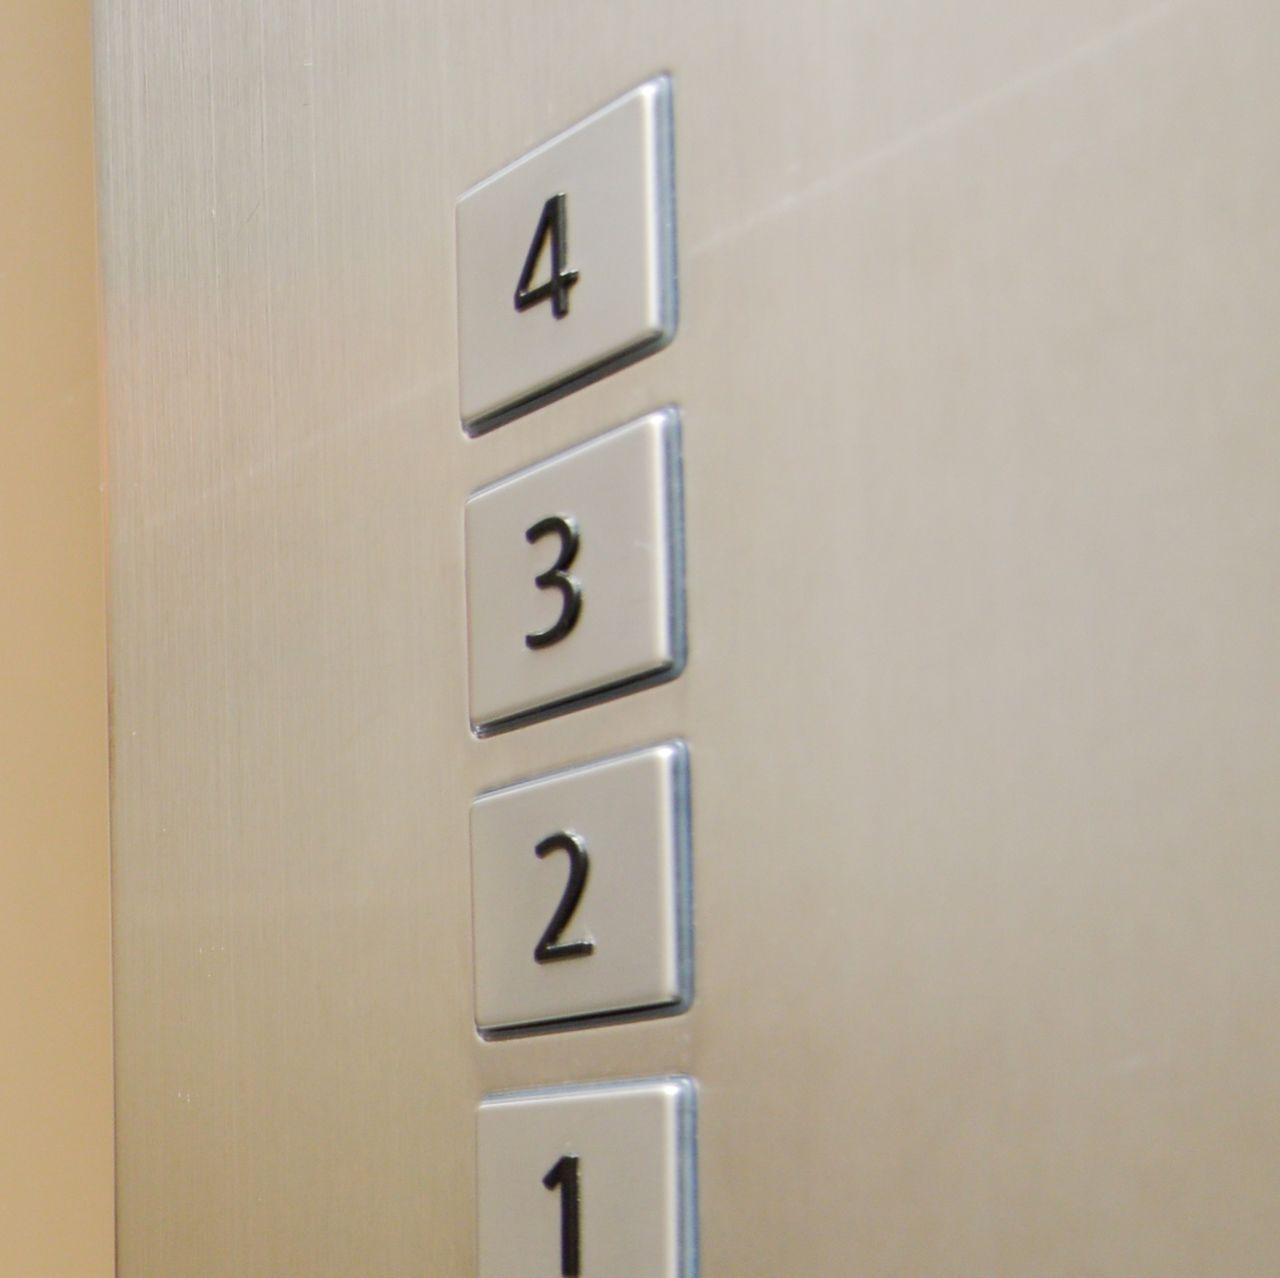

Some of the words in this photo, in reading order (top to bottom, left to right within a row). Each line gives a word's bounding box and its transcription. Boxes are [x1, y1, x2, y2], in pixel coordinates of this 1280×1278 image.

[514, 193, 578, 319] 4
[525, 516, 583, 650] 3
[534, 832, 594, 964] 2
